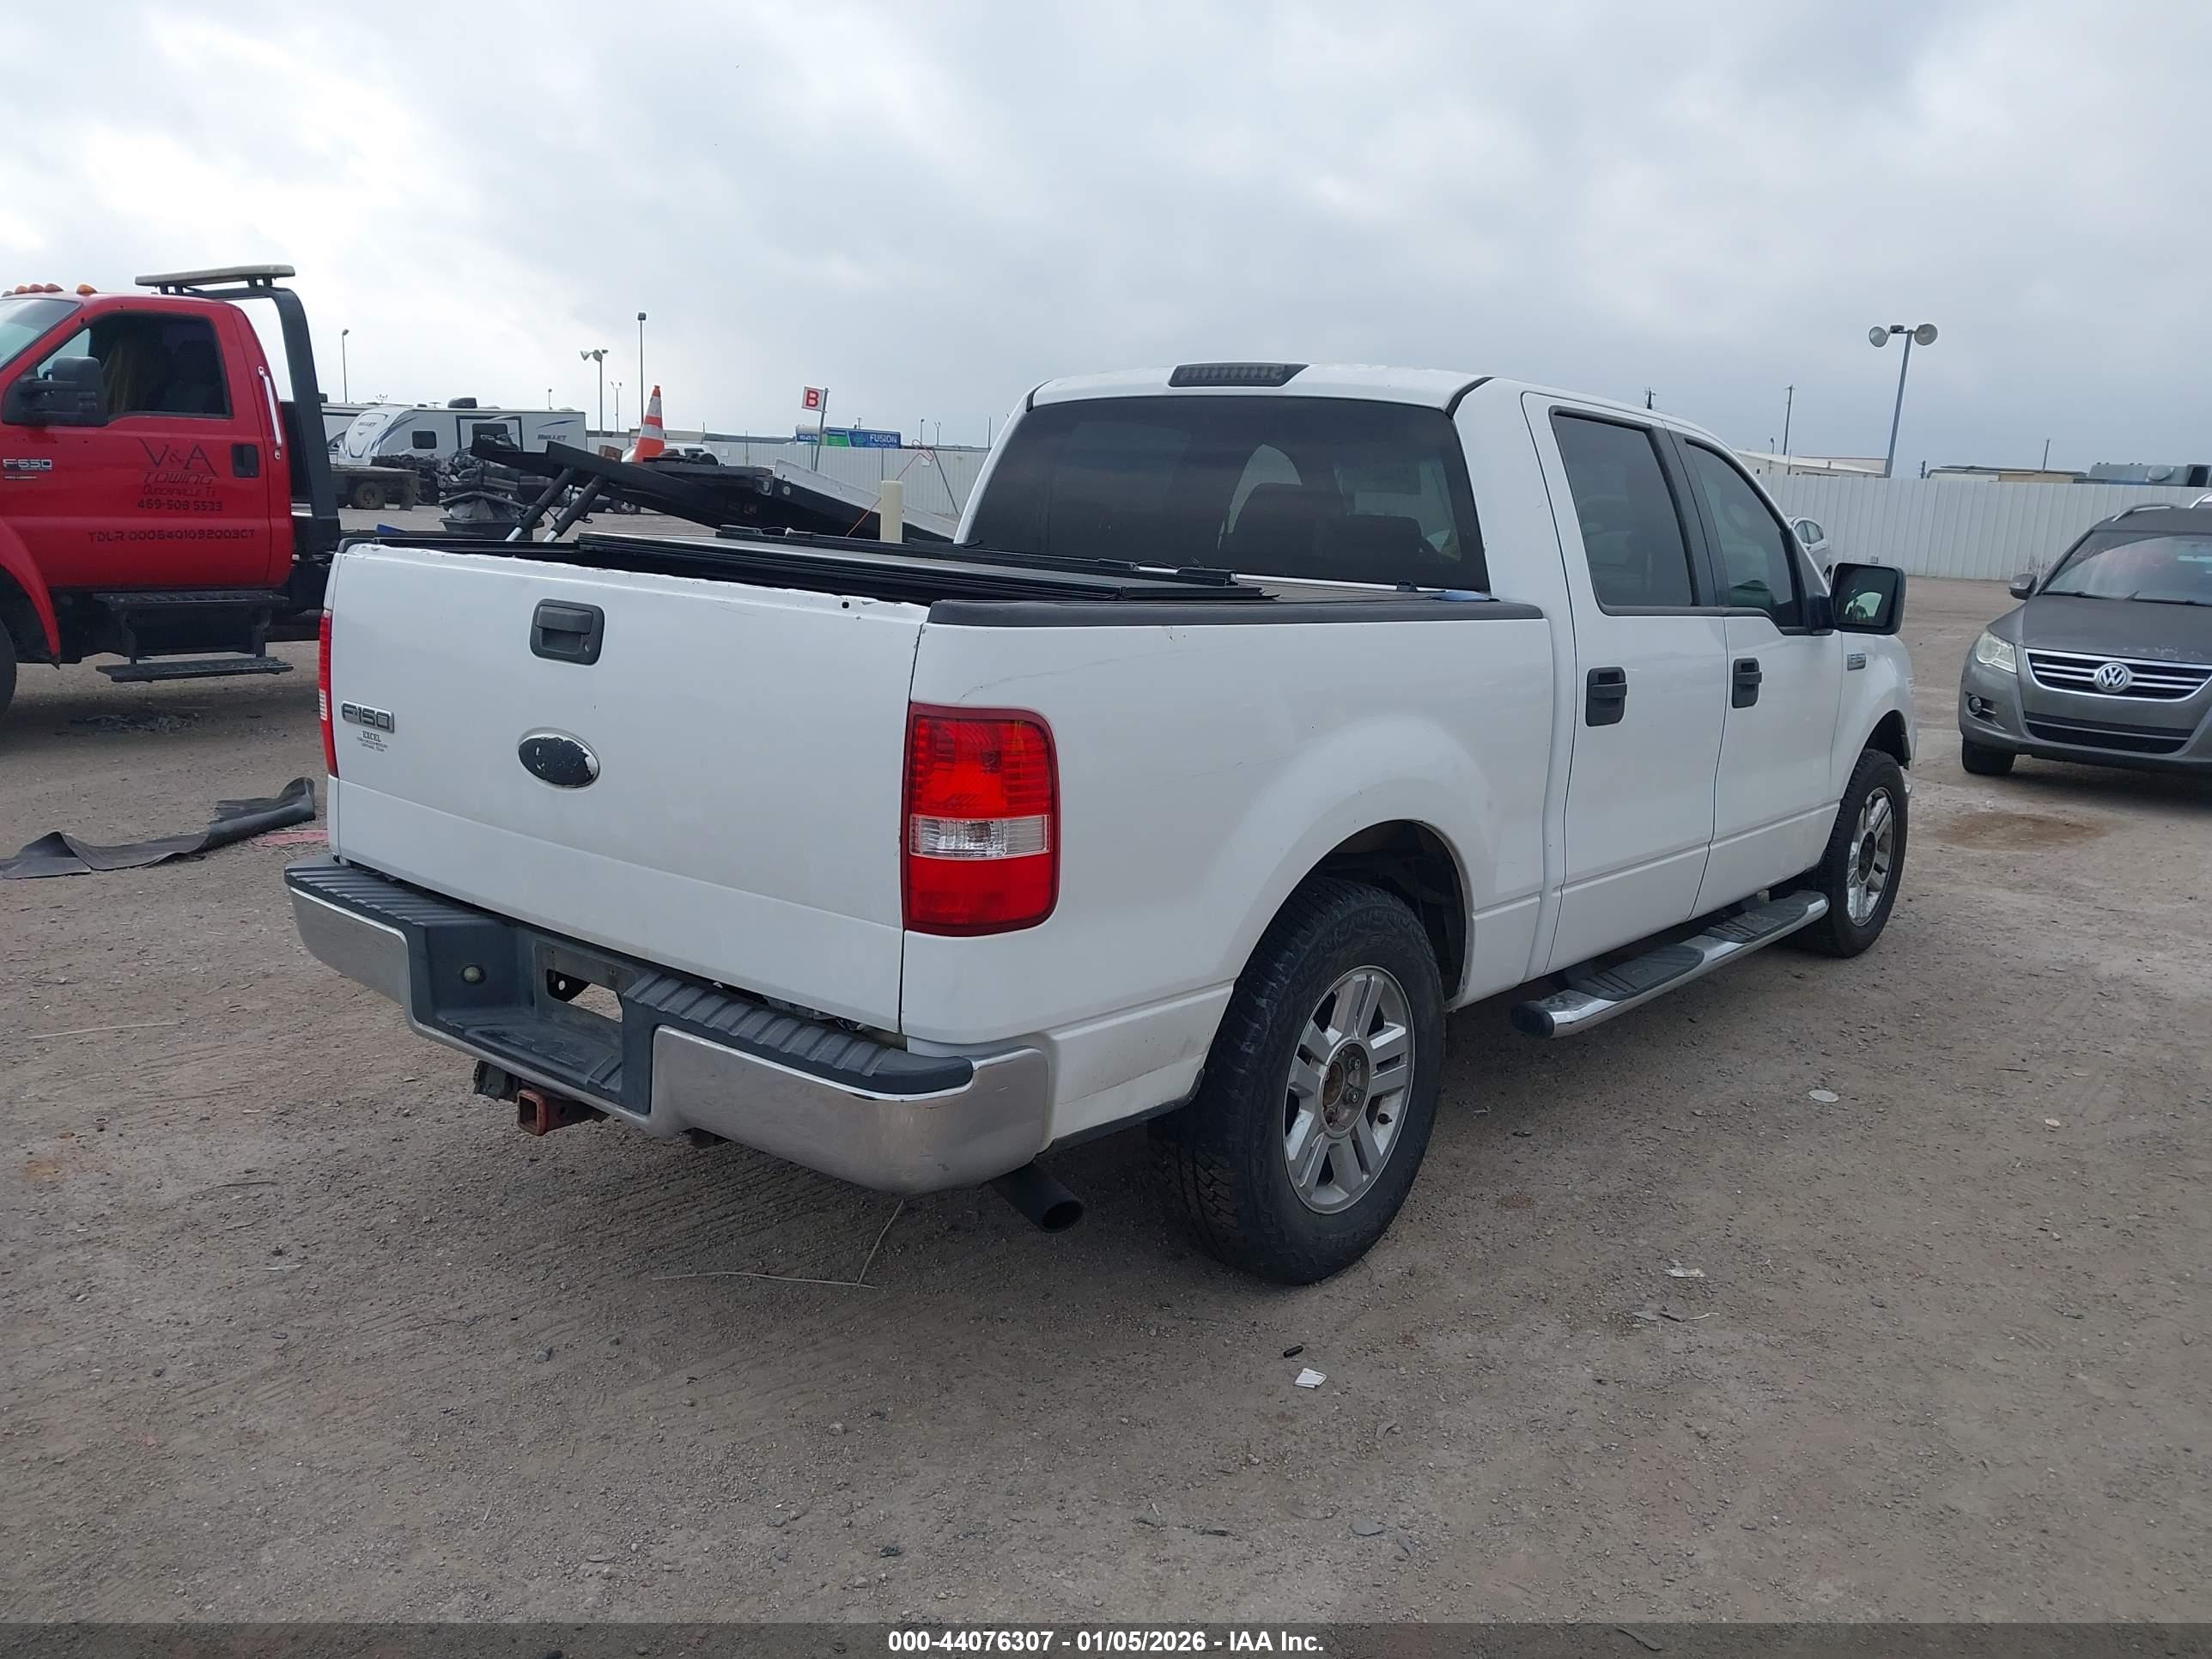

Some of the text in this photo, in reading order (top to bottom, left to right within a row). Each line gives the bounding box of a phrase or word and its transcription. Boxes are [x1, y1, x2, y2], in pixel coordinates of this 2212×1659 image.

[805, 390, 819, 408] B
[870, 434, 897, 443] FUSION
[88, 531, 125, 543] TDLR
[362, 730, 381, 743] EXCEL
